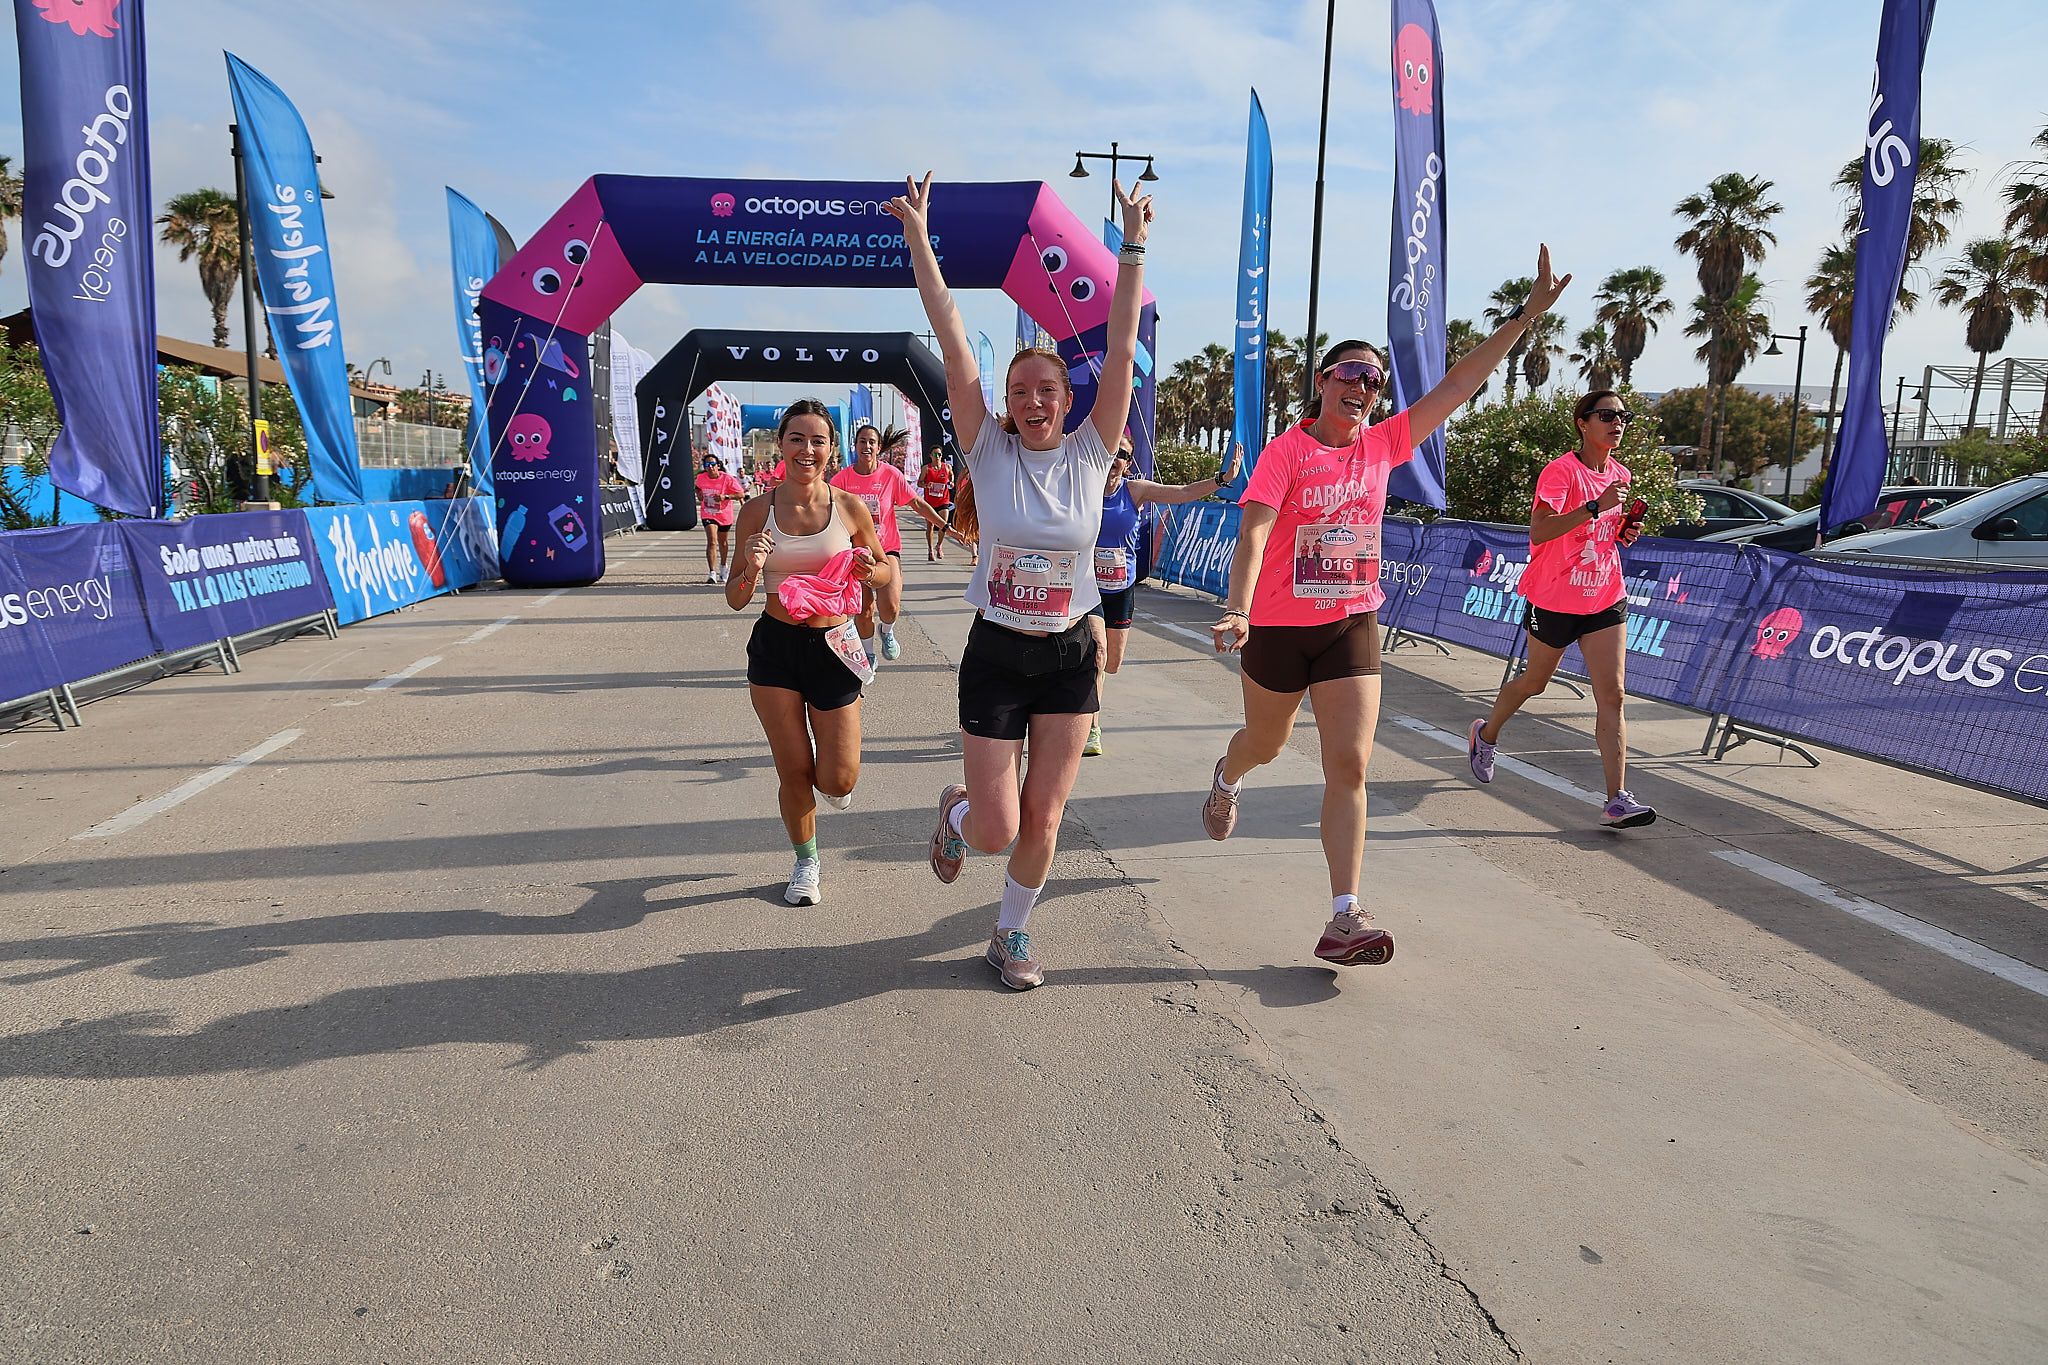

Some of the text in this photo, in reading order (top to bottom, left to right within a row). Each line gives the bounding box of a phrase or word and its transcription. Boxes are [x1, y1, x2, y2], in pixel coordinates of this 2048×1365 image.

[744, 196, 845, 220] octopus
[696, 228, 941, 249] LA ENERGÍA PARA CORR
[695, 250, 708, 263] A
[713, 251, 737, 264] LA
[742, 251, 848, 267] VELOCIDAD
[851, 254, 878, 267] DE
[880, 254, 903, 268] LA
[726, 345, 880, 363] VOLVO
[655, 405, 674, 515] VOLVO
[496, 468, 578, 483] octopus energy
[160, 544, 200, 576] Solo
[200, 543, 235, 570] unos
[232, 536, 278, 565] metros
[1172, 506, 1238, 587] Marlen
[327, 511, 418, 618] Marlene
[1017, 560, 1050, 569] ASTURIANA
[1096, 566, 1114, 575] 016
[1322, 558, 1354, 571] 016
[169, 560, 312, 613] YA LO HAS CONSEGUIDO
[1379, 559, 1433, 596] energy
[26, 575, 114, 620] energy
[1013, 585, 1048, 601] 016
[1315, 598, 1337, 610] 2026
[1462, 585, 1504, 621] PARA
[995, 611, 1021, 623] OYSHO
[1809, 625, 2013, 687] octopus
